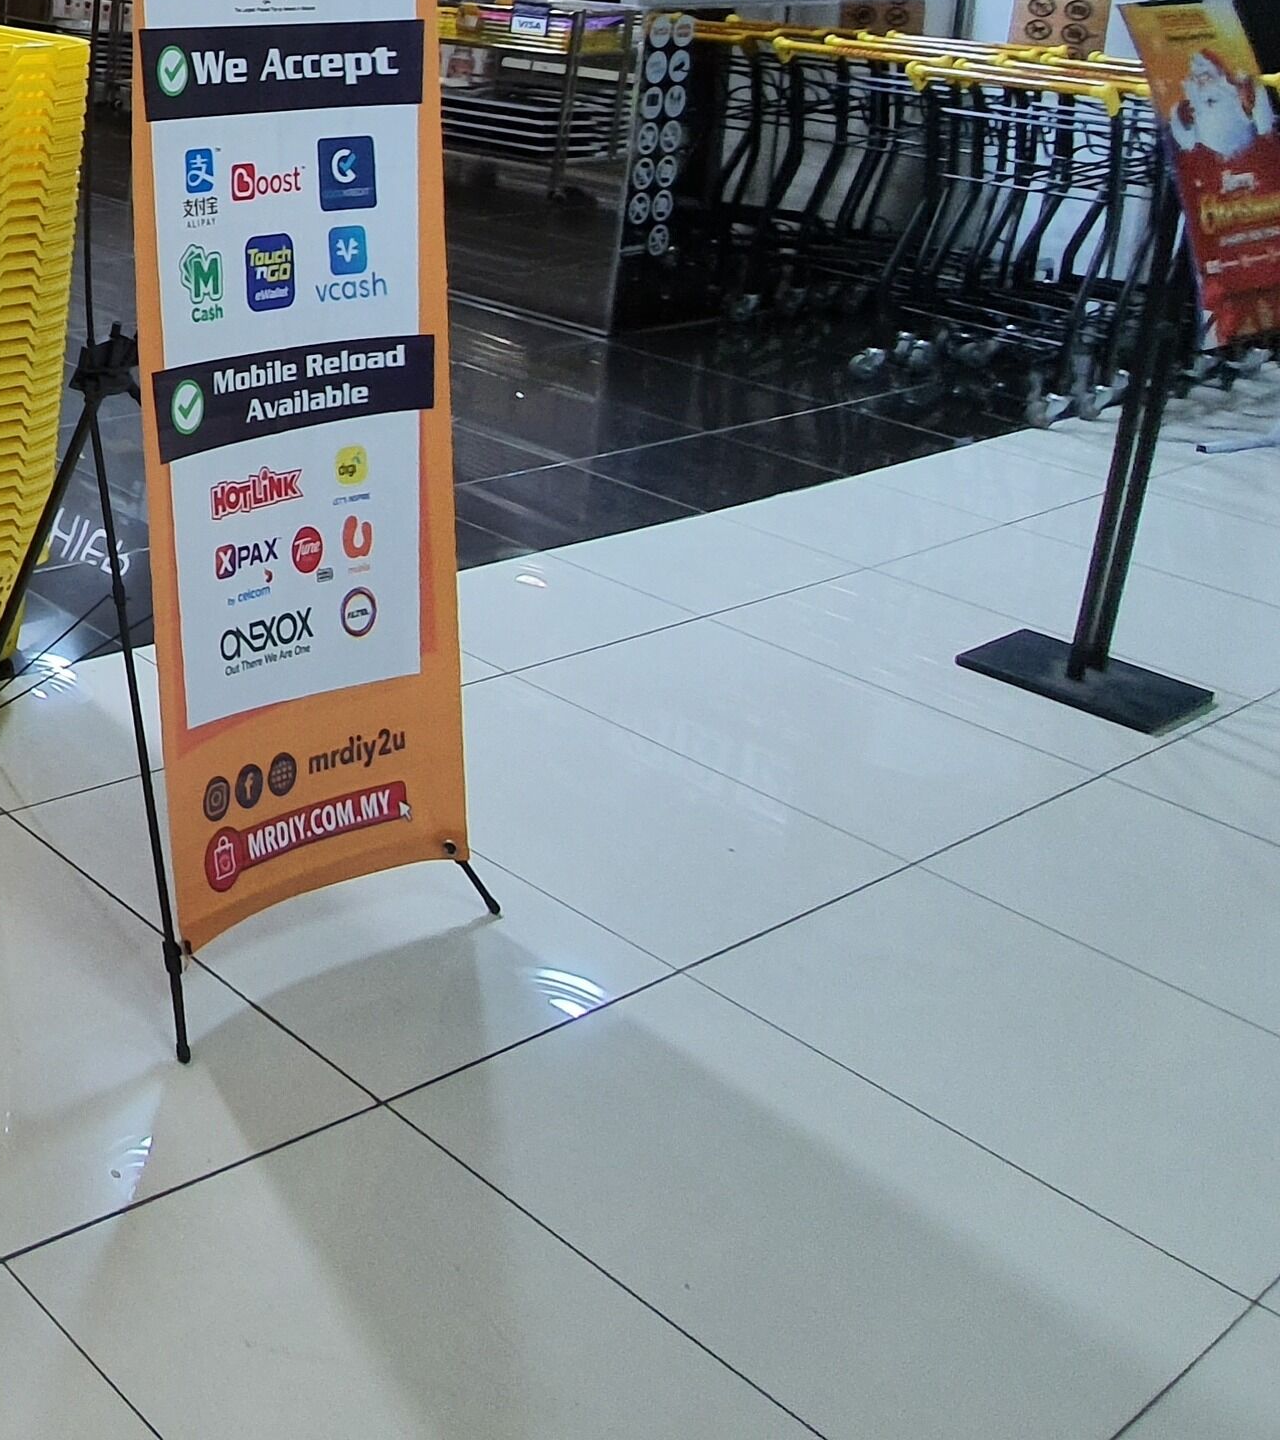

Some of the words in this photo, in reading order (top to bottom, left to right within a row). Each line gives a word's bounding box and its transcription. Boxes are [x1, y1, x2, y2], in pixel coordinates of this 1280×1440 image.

[517, 20, 542, 30] VISA
[191, 50, 249, 85] We
[259, 46, 400, 86] Accept
[233, 164, 302, 200] Boost
[186, 218, 217, 229] ALIPAY
[247, 245, 292, 267] Touch
[315, 272, 388, 303] vcash
[213, 360, 297, 396] Mobile
[305, 344, 407, 379] Reload
[245, 382, 370, 424] Available
[216, 537, 279, 578] XPAX
[237, 586, 271, 603] celcom
[224, 663, 240, 677] Out
[241, 657, 263, 674] There
[279, 649, 293, 660] Are
[294, 644, 311, 656] One
[307, 728, 406, 776] mrdiy2u
[246, 789, 392, 861] MRDIY.COM.MY
